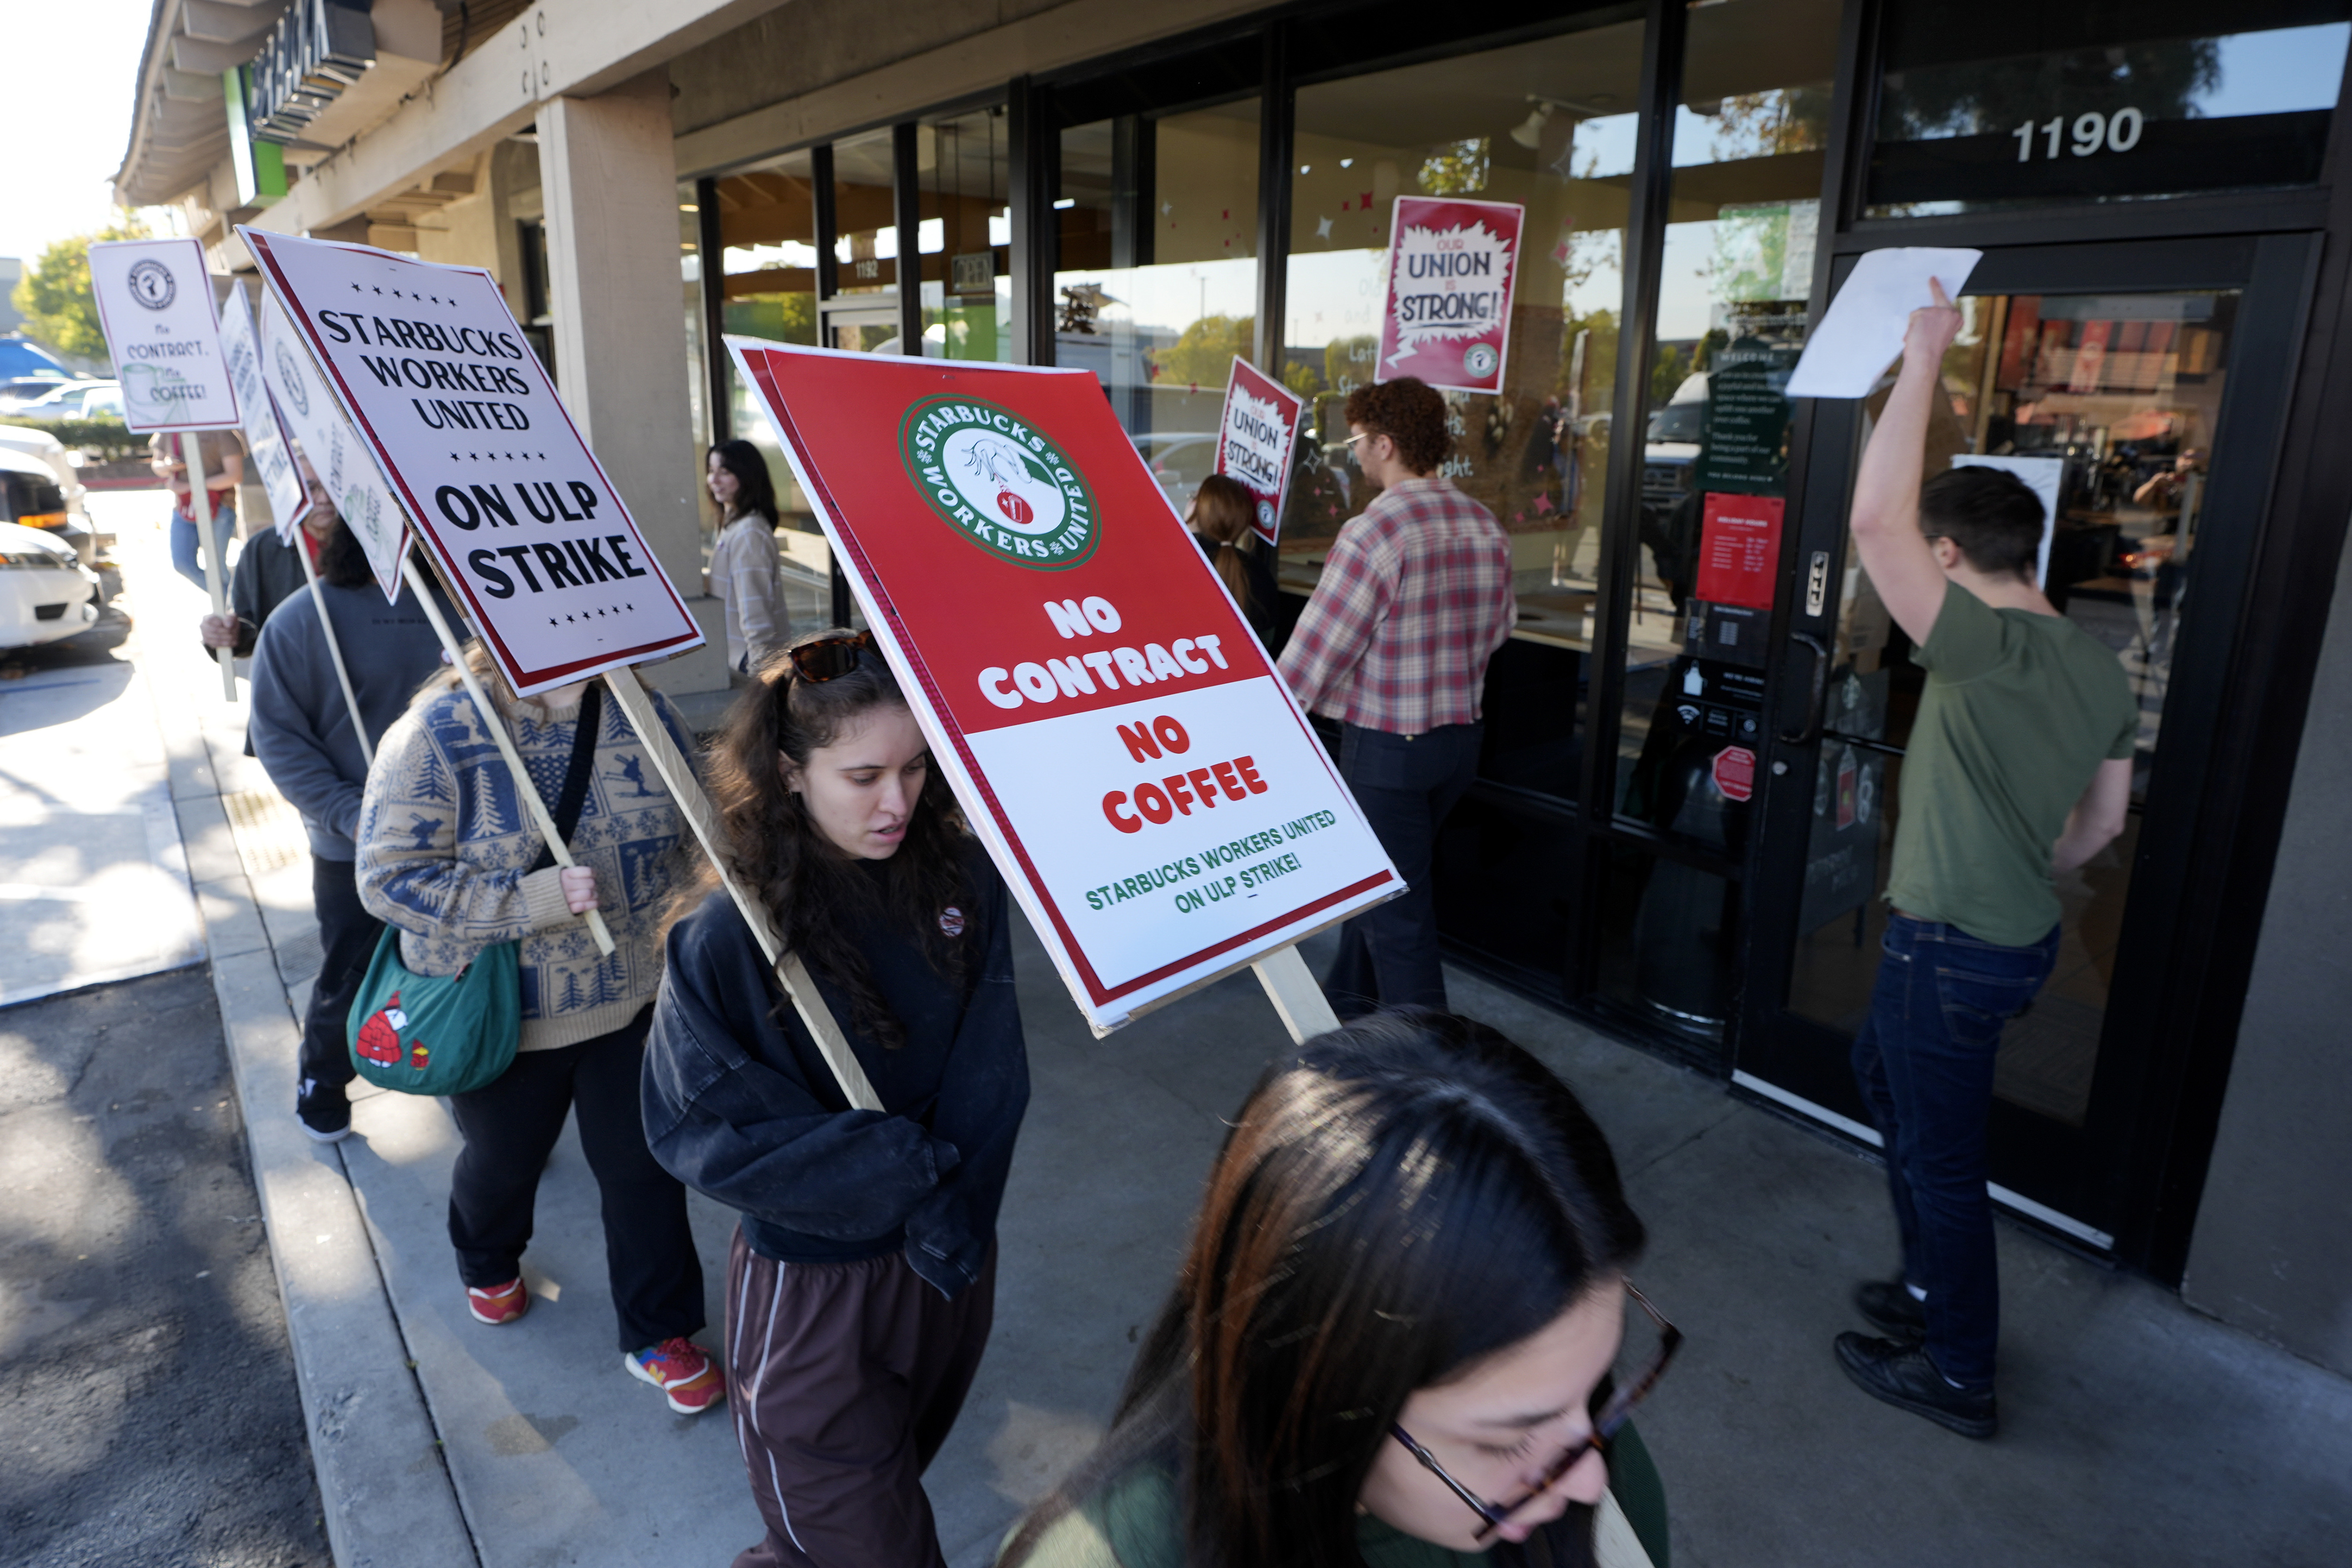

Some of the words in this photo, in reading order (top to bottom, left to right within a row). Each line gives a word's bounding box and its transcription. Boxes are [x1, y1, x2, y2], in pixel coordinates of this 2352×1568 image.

[2013, 107, 2143, 162] 1190
[1409, 252, 1490, 277] UNION
[1437, 239, 1464, 250] OUR
[1402, 291, 1497, 321] STRONG!
[1446, 280, 1456, 291] IS
[318, 310, 523, 359] STARBUCKS
[360, 355, 530, 395] WORKERS
[412, 399, 529, 430] UNITED
[915, 405, 1046, 452] STARBUCKS
[1234, 408, 1278, 449] UNION
[1228, 440, 1279, 486] STRONG!
[435, 484, 519, 531] ON
[514, 481, 597, 524] ULP
[922, 465, 1049, 558] WORKERS
[1055, 467, 1089, 551] UNITED
[468, 535, 647, 599] STRIKE
[1043, 596, 1122, 638] NO
[977, 634, 1229, 709] CONTRACT
[1115, 715, 1191, 763] NO
[1102, 755, 1269, 833] COFFEE
[1086, 857, 1200, 911] STARBUCKS
[1199, 828, 1284, 869] WORKERS
[1281, 810, 1336, 839] UNITED
[1175, 889, 1207, 913] ON
[1203, 876, 1236, 902] ULP
[1240, 852, 1303, 888] STRIKE!
